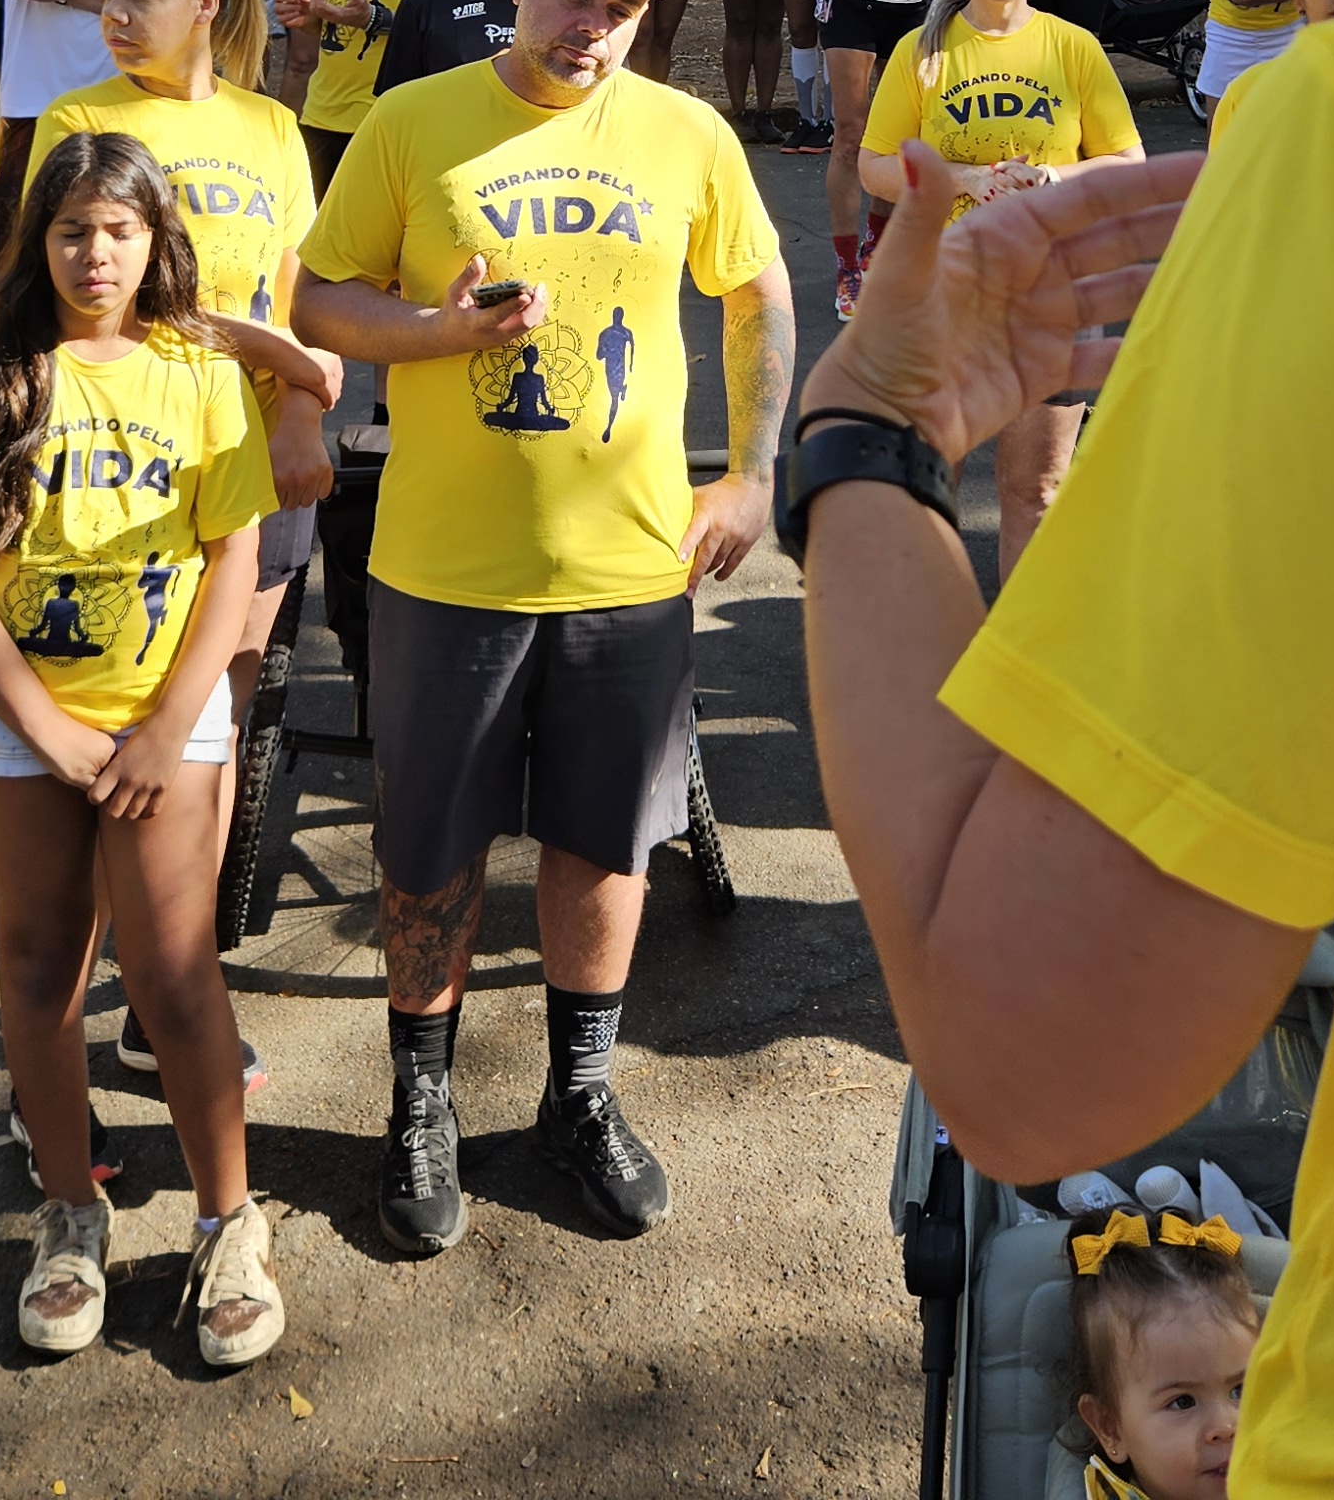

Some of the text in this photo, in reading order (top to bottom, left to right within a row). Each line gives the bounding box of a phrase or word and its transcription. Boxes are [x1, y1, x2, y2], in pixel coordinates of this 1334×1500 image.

[484, 24, 516, 43] PER
[940, 73, 1049, 101] VIBRANDO PELA
[945, 93, 1055, 126] VIDA
[161, 157, 264, 186] RANDO PELA
[475, 167, 634, 199] VIBRANDO PELA
[479, 196, 642, 244] VIDA
[45, 417, 174, 452] RANDO PELA
[31, 450, 171, 499] VIDA
